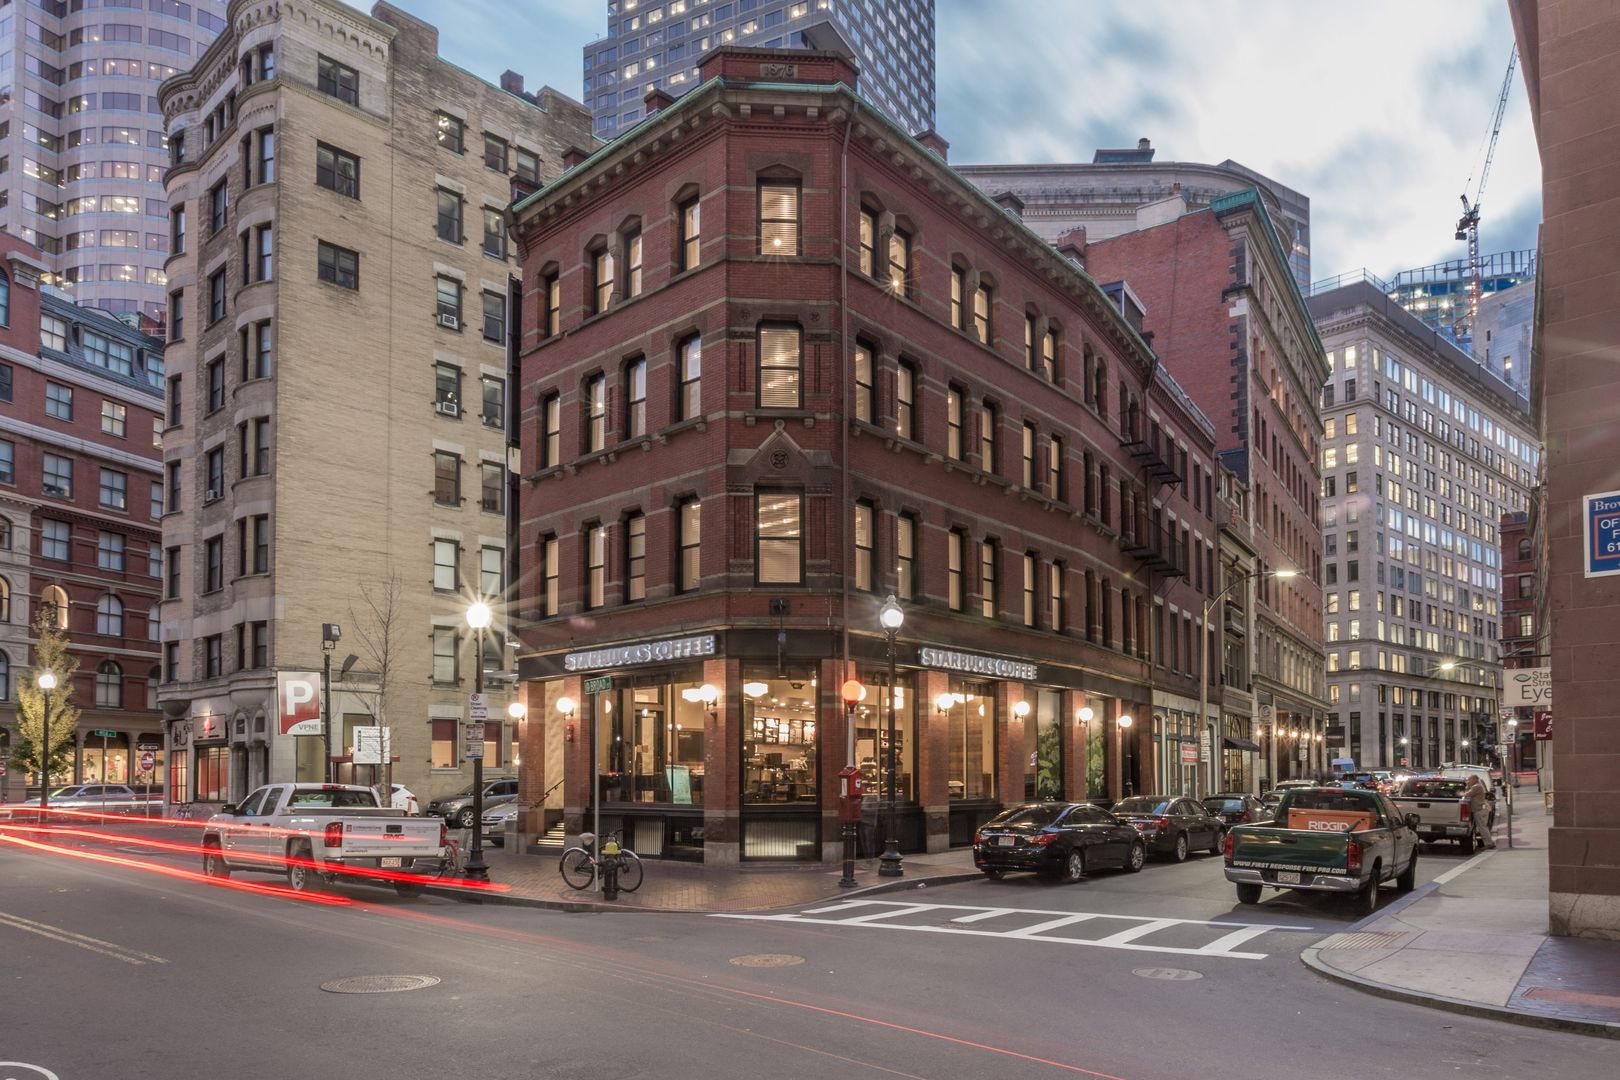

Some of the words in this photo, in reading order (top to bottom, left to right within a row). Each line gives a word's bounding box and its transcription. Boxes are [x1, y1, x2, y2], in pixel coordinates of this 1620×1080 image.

[564, 644, 652, 671] STARBUCKS
[651, 634, 716, 661] COFFEE
[921, 647, 997, 675] STARBUCKS
[996, 659, 1038, 680] COFFEE
[589, 679, 606, 691] BROAD
[1521, 684, 1552, 703] Eye
[285, 680, 314, 716] P
[1308, 821, 1349, 831] RIDGID
[1269, 863, 1302, 871] RESPONSE
[1301, 865, 1317, 873] FIRE
